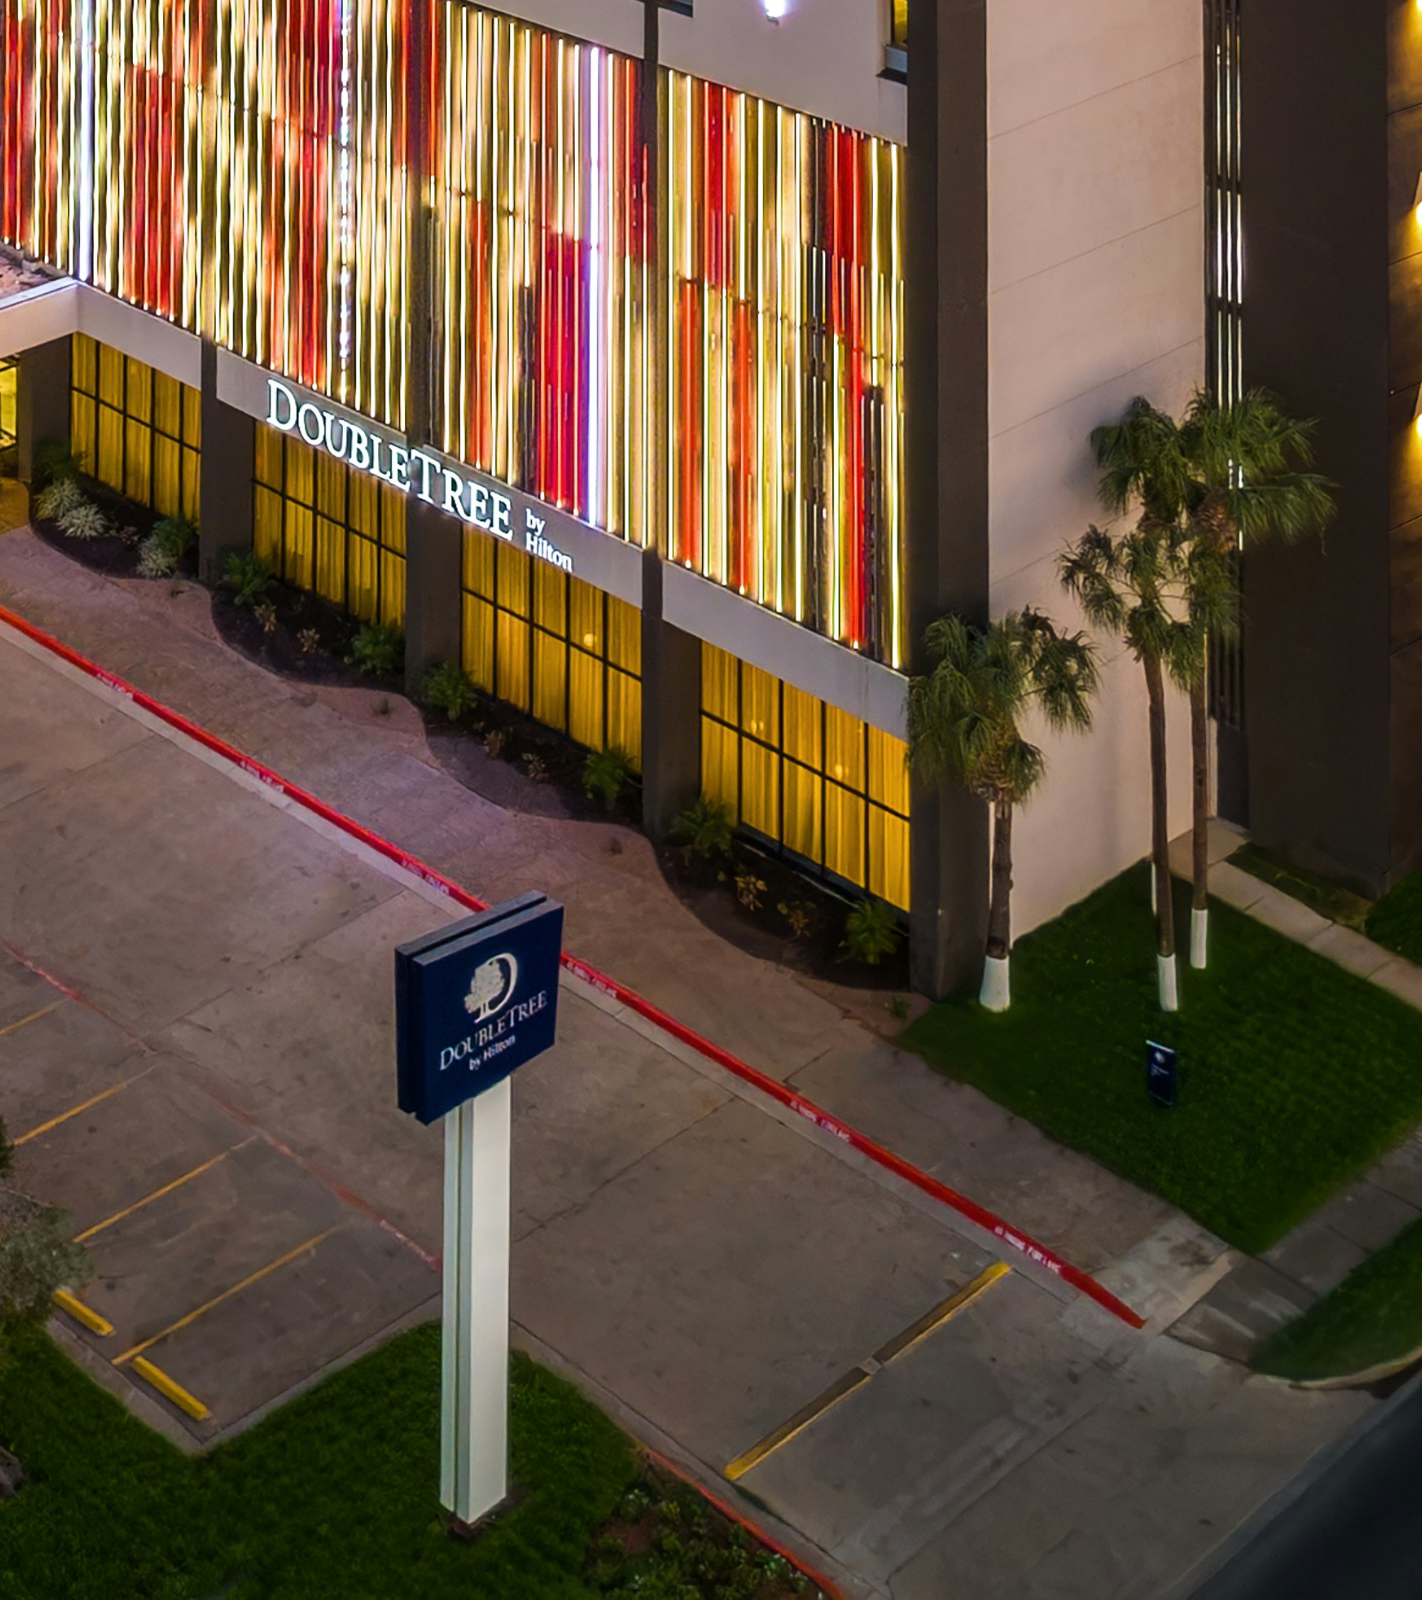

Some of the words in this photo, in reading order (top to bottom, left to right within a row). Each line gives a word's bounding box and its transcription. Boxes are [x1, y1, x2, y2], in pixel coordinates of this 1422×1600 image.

[525, 508, 546, 536] by
[525, 531, 574, 573] Hilton
[468, 1057, 482, 1071] by
[483, 1034, 516, 1062] Hilton
